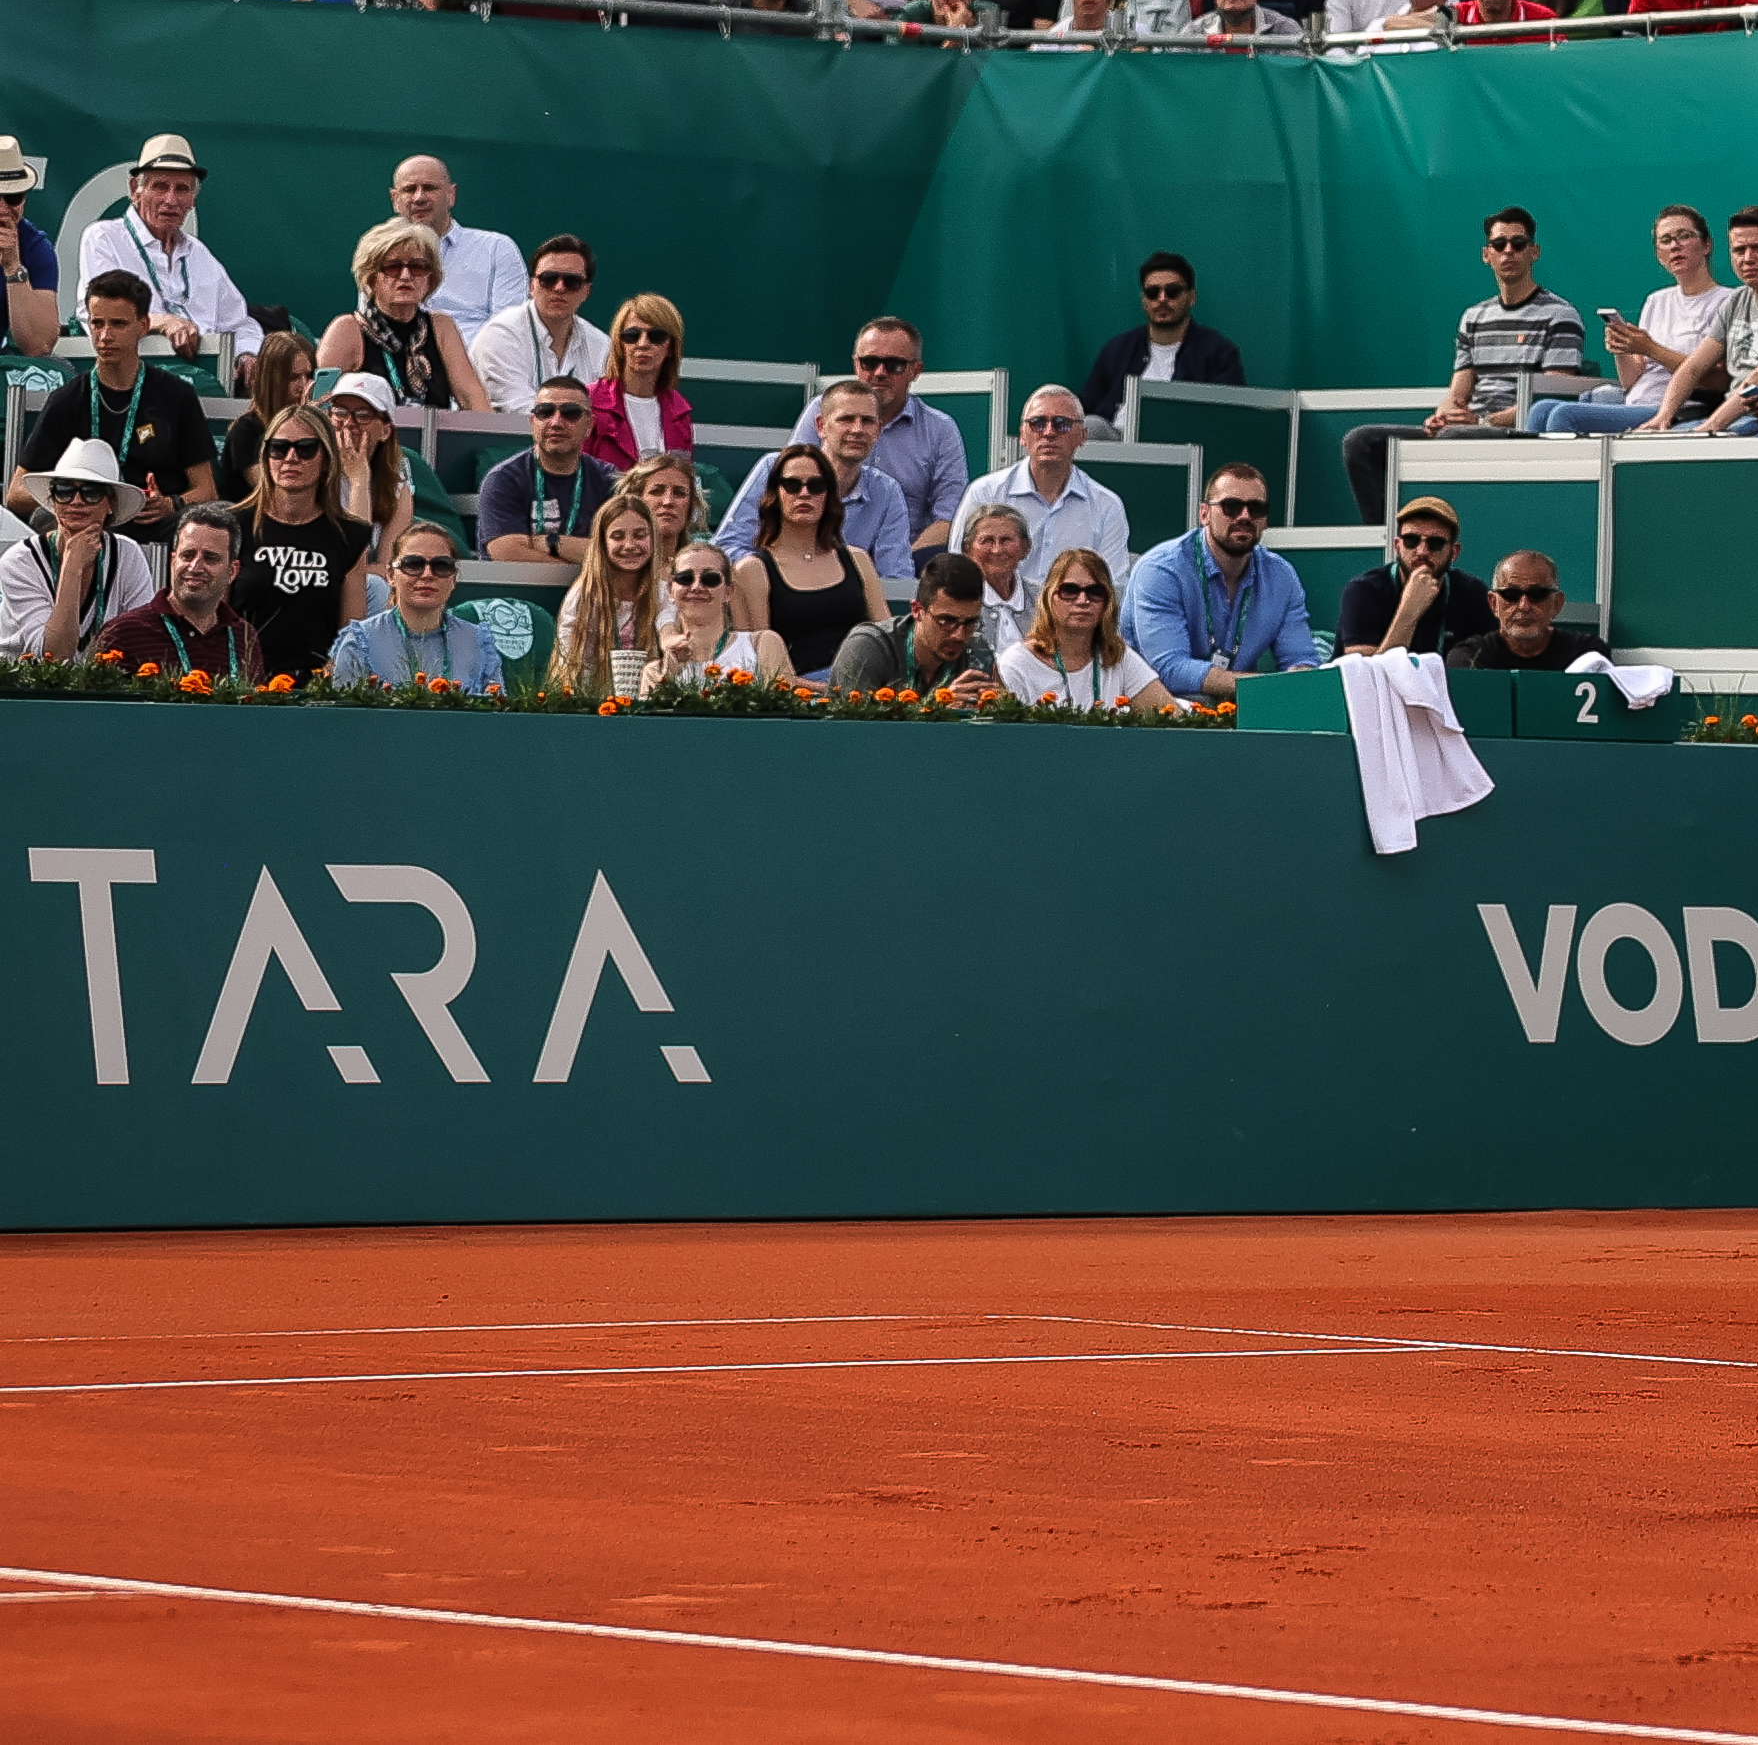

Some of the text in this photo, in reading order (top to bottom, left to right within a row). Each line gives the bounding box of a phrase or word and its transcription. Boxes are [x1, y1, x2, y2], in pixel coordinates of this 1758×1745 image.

[254, 546, 327, 568] WILD
[273, 565, 329, 594] LOVE
[1574, 681, 1600, 724] 2
[28, 847, 713, 1087] TARA
